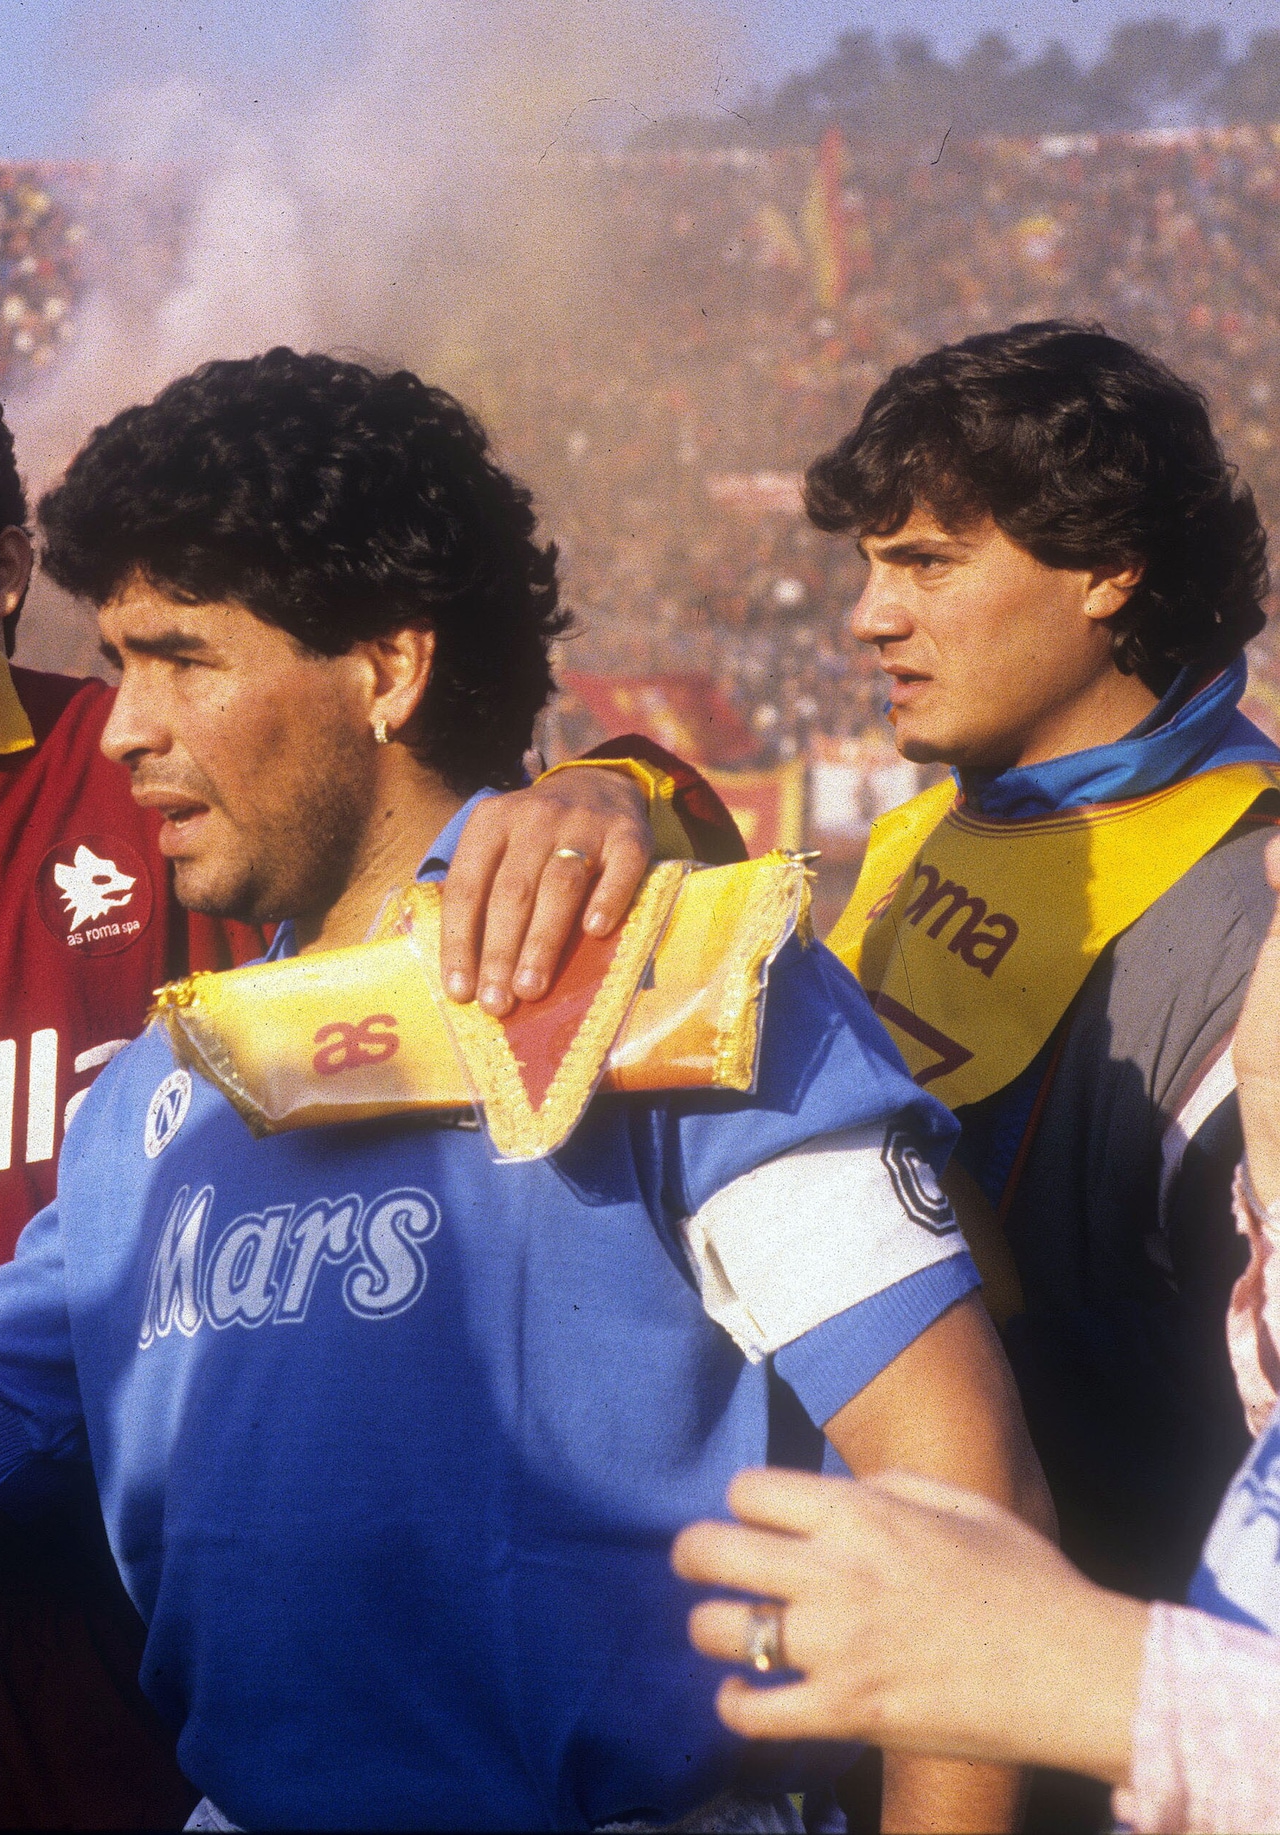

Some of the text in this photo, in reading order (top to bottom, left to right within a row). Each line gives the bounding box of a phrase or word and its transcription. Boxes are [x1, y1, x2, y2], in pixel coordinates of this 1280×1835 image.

[66, 919, 141, 947] as roma spa
[312, 1013, 400, 1077] as
[137, 1184, 442, 1350] Mars
